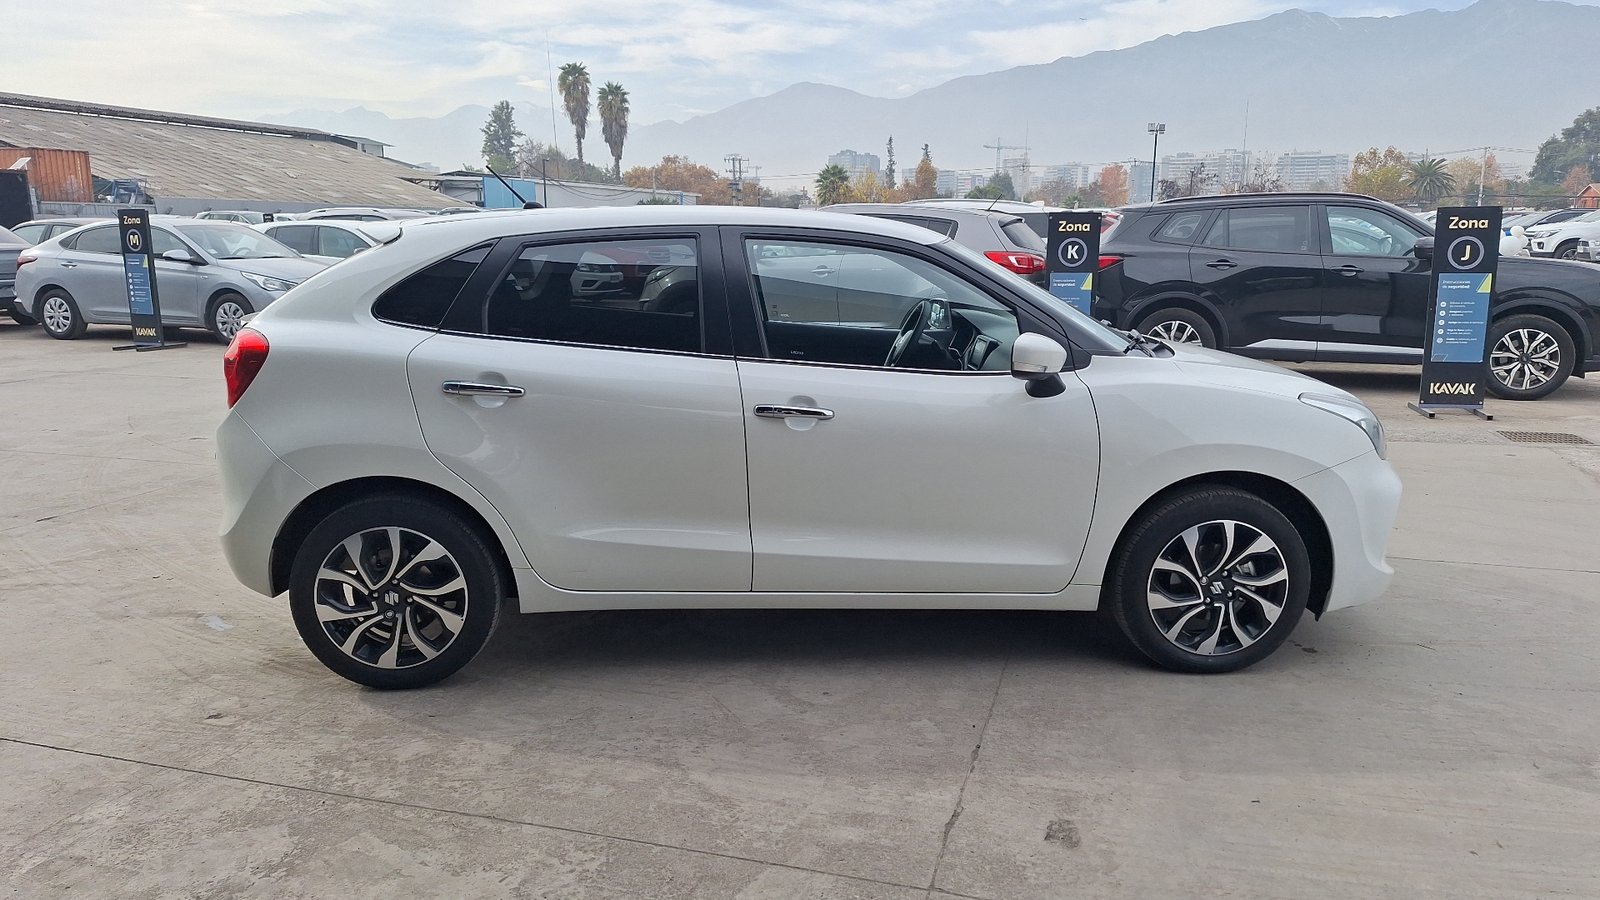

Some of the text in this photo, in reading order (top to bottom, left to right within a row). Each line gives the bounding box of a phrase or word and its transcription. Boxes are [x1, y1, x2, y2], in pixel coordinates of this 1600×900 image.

[123, 215, 141, 225] Zona
[1058, 220, 1091, 232] Zona
[1448, 216, 1489, 229] Zona
[129, 234, 139, 246] M
[1067, 244, 1080, 259] K
[1460, 244, 1471, 261] J
[135, 327, 157, 337] KAVAK
[1429, 382, 1476, 395] KAVAK
